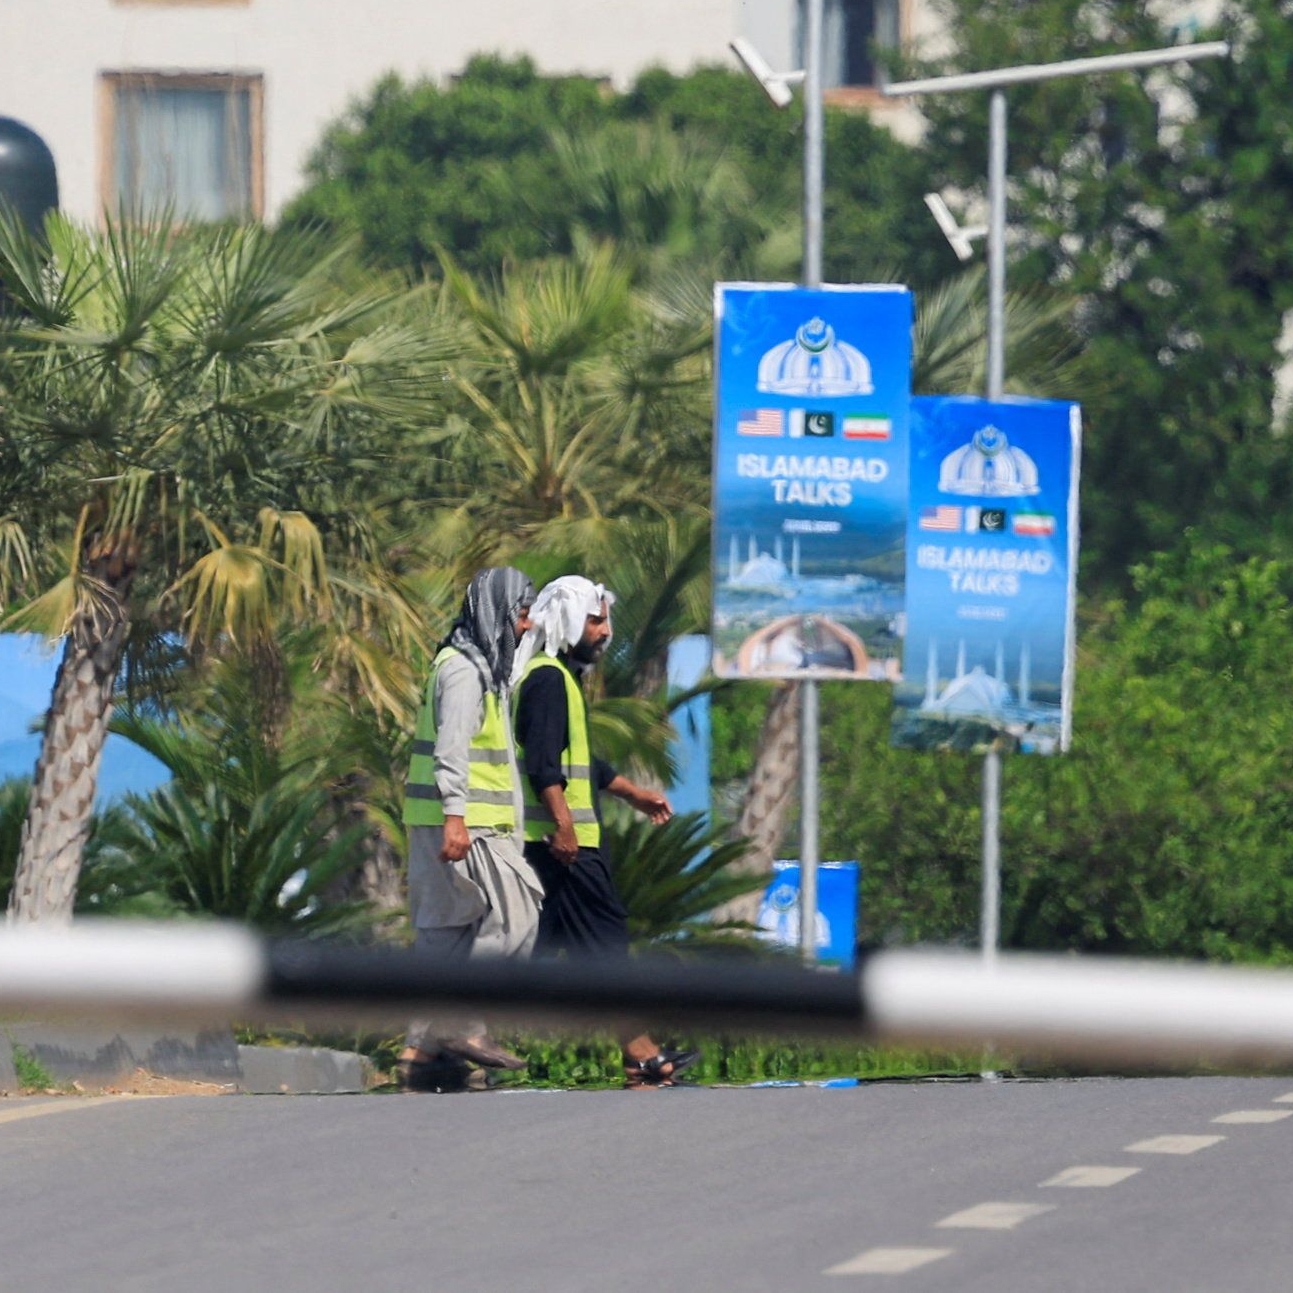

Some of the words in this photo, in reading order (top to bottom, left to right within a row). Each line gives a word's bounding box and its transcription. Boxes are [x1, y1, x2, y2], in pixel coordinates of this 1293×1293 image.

[737, 454, 889, 482] ISLAMABAD
[771, 479, 853, 506] TALKS
[917, 545, 1052, 574] ISLAMABAD
[949, 570, 1019, 596] TALKS
